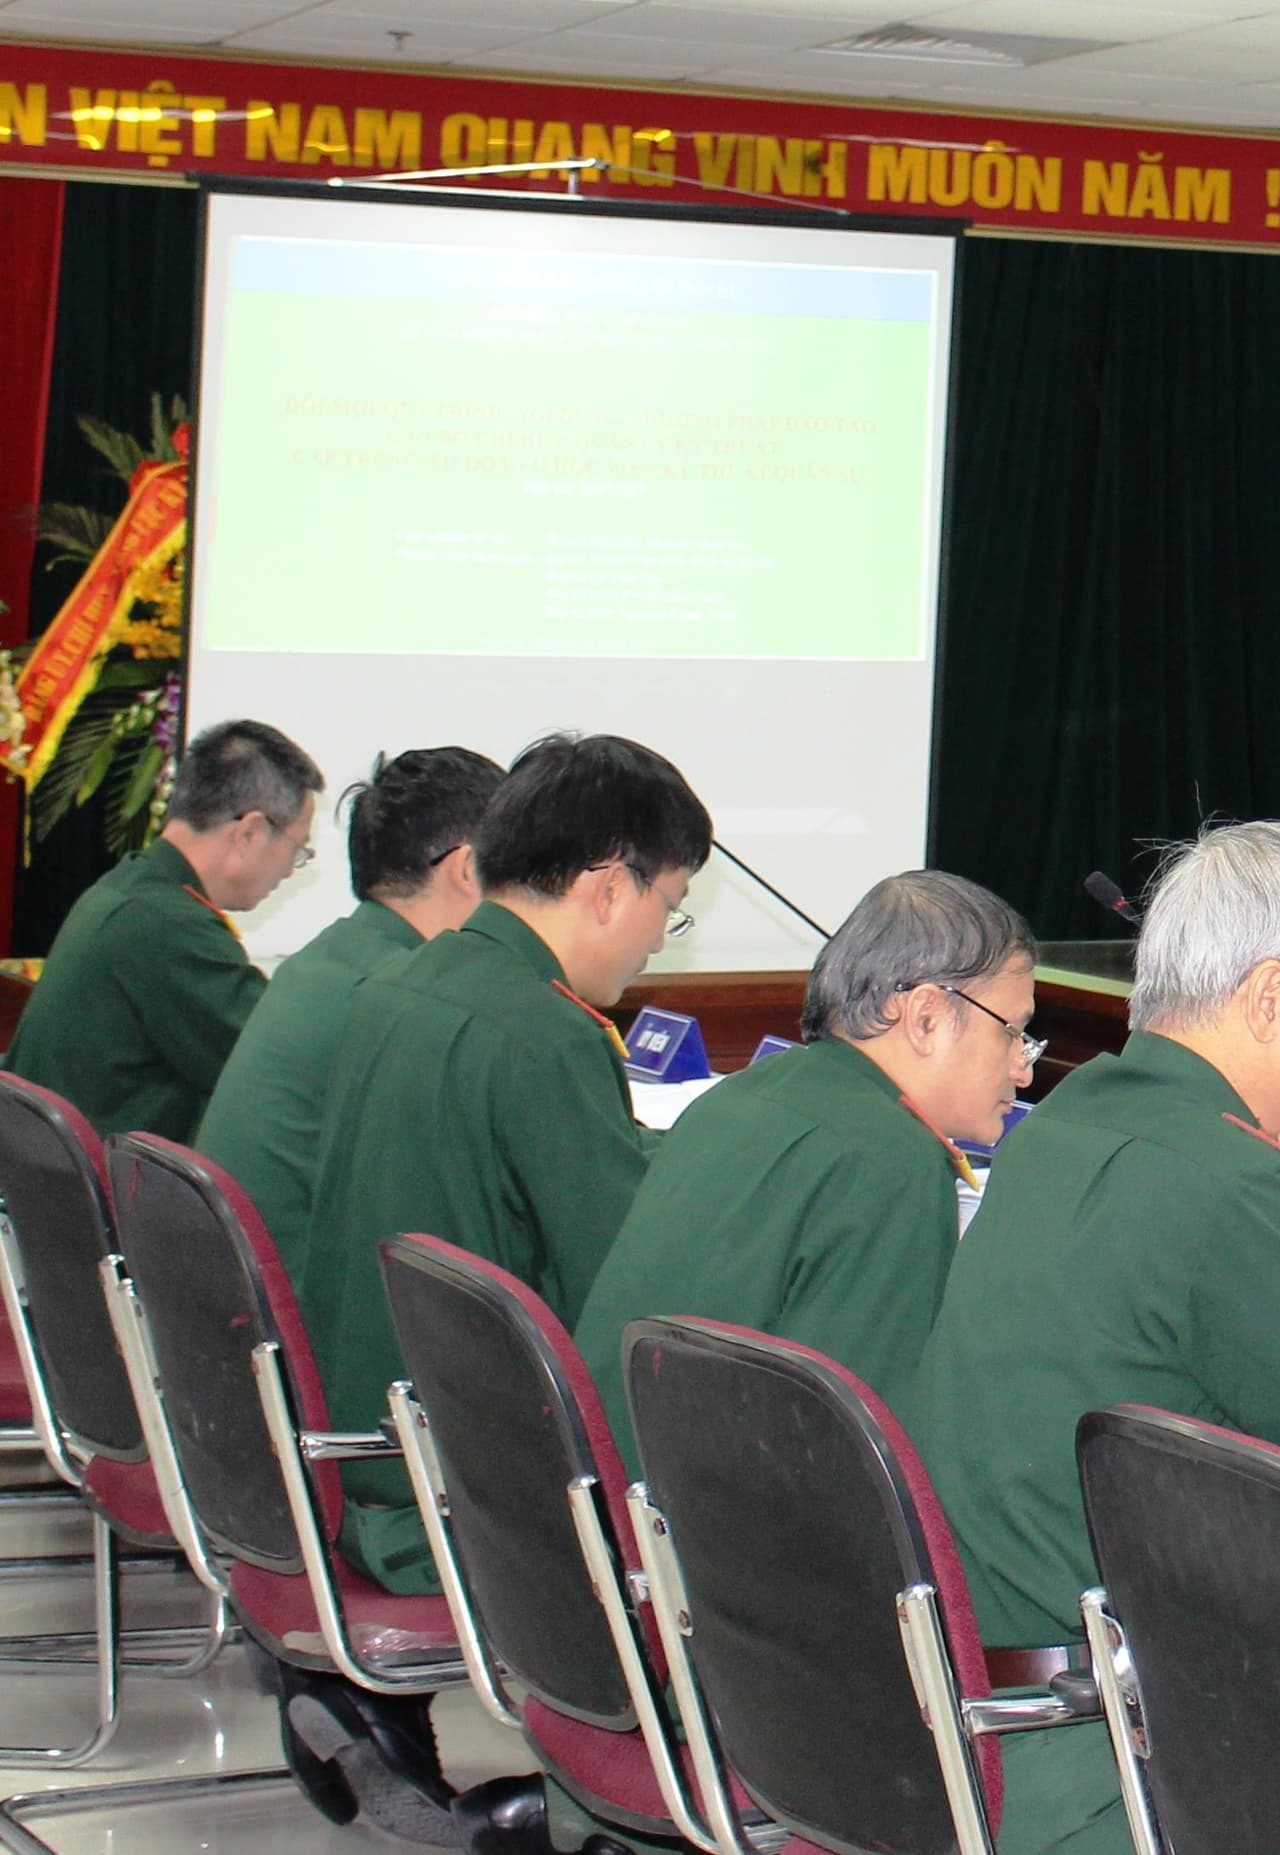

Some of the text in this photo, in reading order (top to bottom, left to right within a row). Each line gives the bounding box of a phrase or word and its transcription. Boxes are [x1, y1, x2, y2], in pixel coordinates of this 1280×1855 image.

[70, 79, 226, 167] VIỆT
[246, 100, 422, 170] NAM
[440, 112, 676, 187] QUANG
[694, 131, 848, 199] VINH
[866, 140, 1062, 213] MUÔN
[1082, 151, 1231, 223] NĂM
